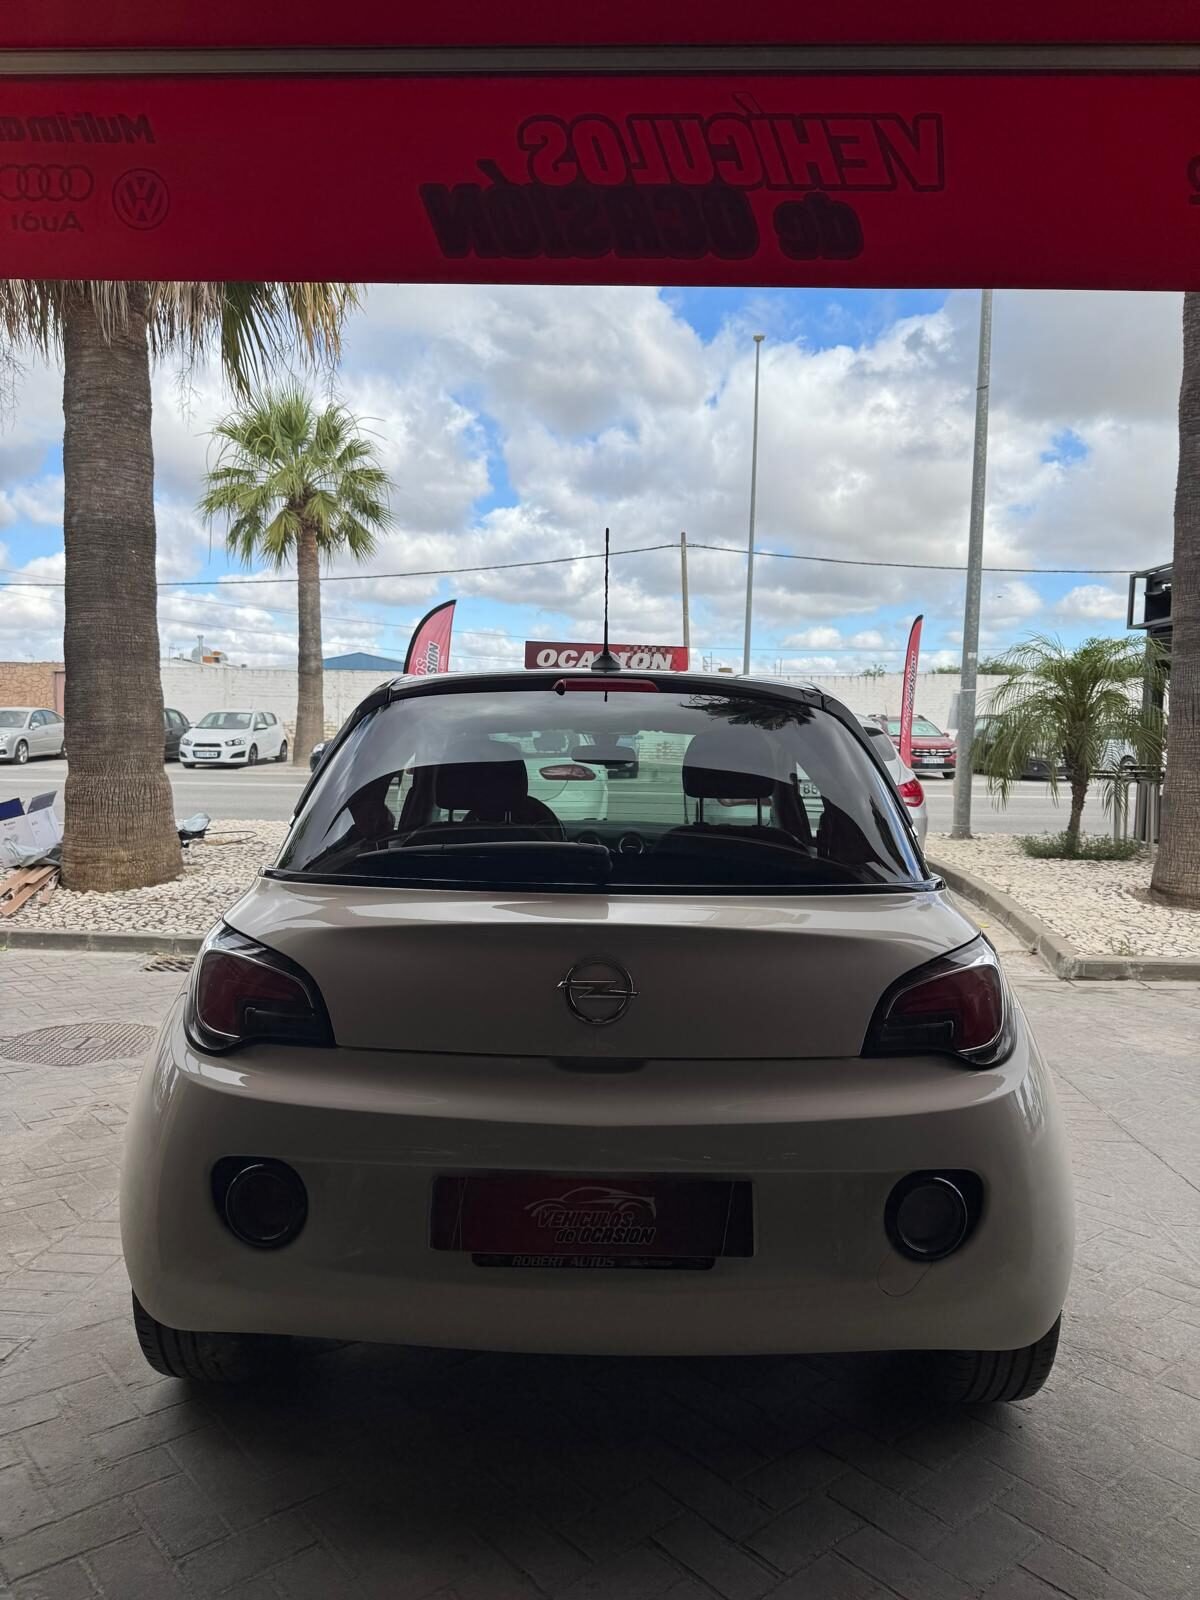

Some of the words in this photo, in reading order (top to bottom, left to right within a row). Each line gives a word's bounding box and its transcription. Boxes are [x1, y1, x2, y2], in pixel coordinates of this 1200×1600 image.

[536, 648, 673, 671] OCAION
[554, 1227, 577, 1244] de
[511, 1255, 565, 1267] ROBERT
[569, 1256, 616, 1268] AUTOS
